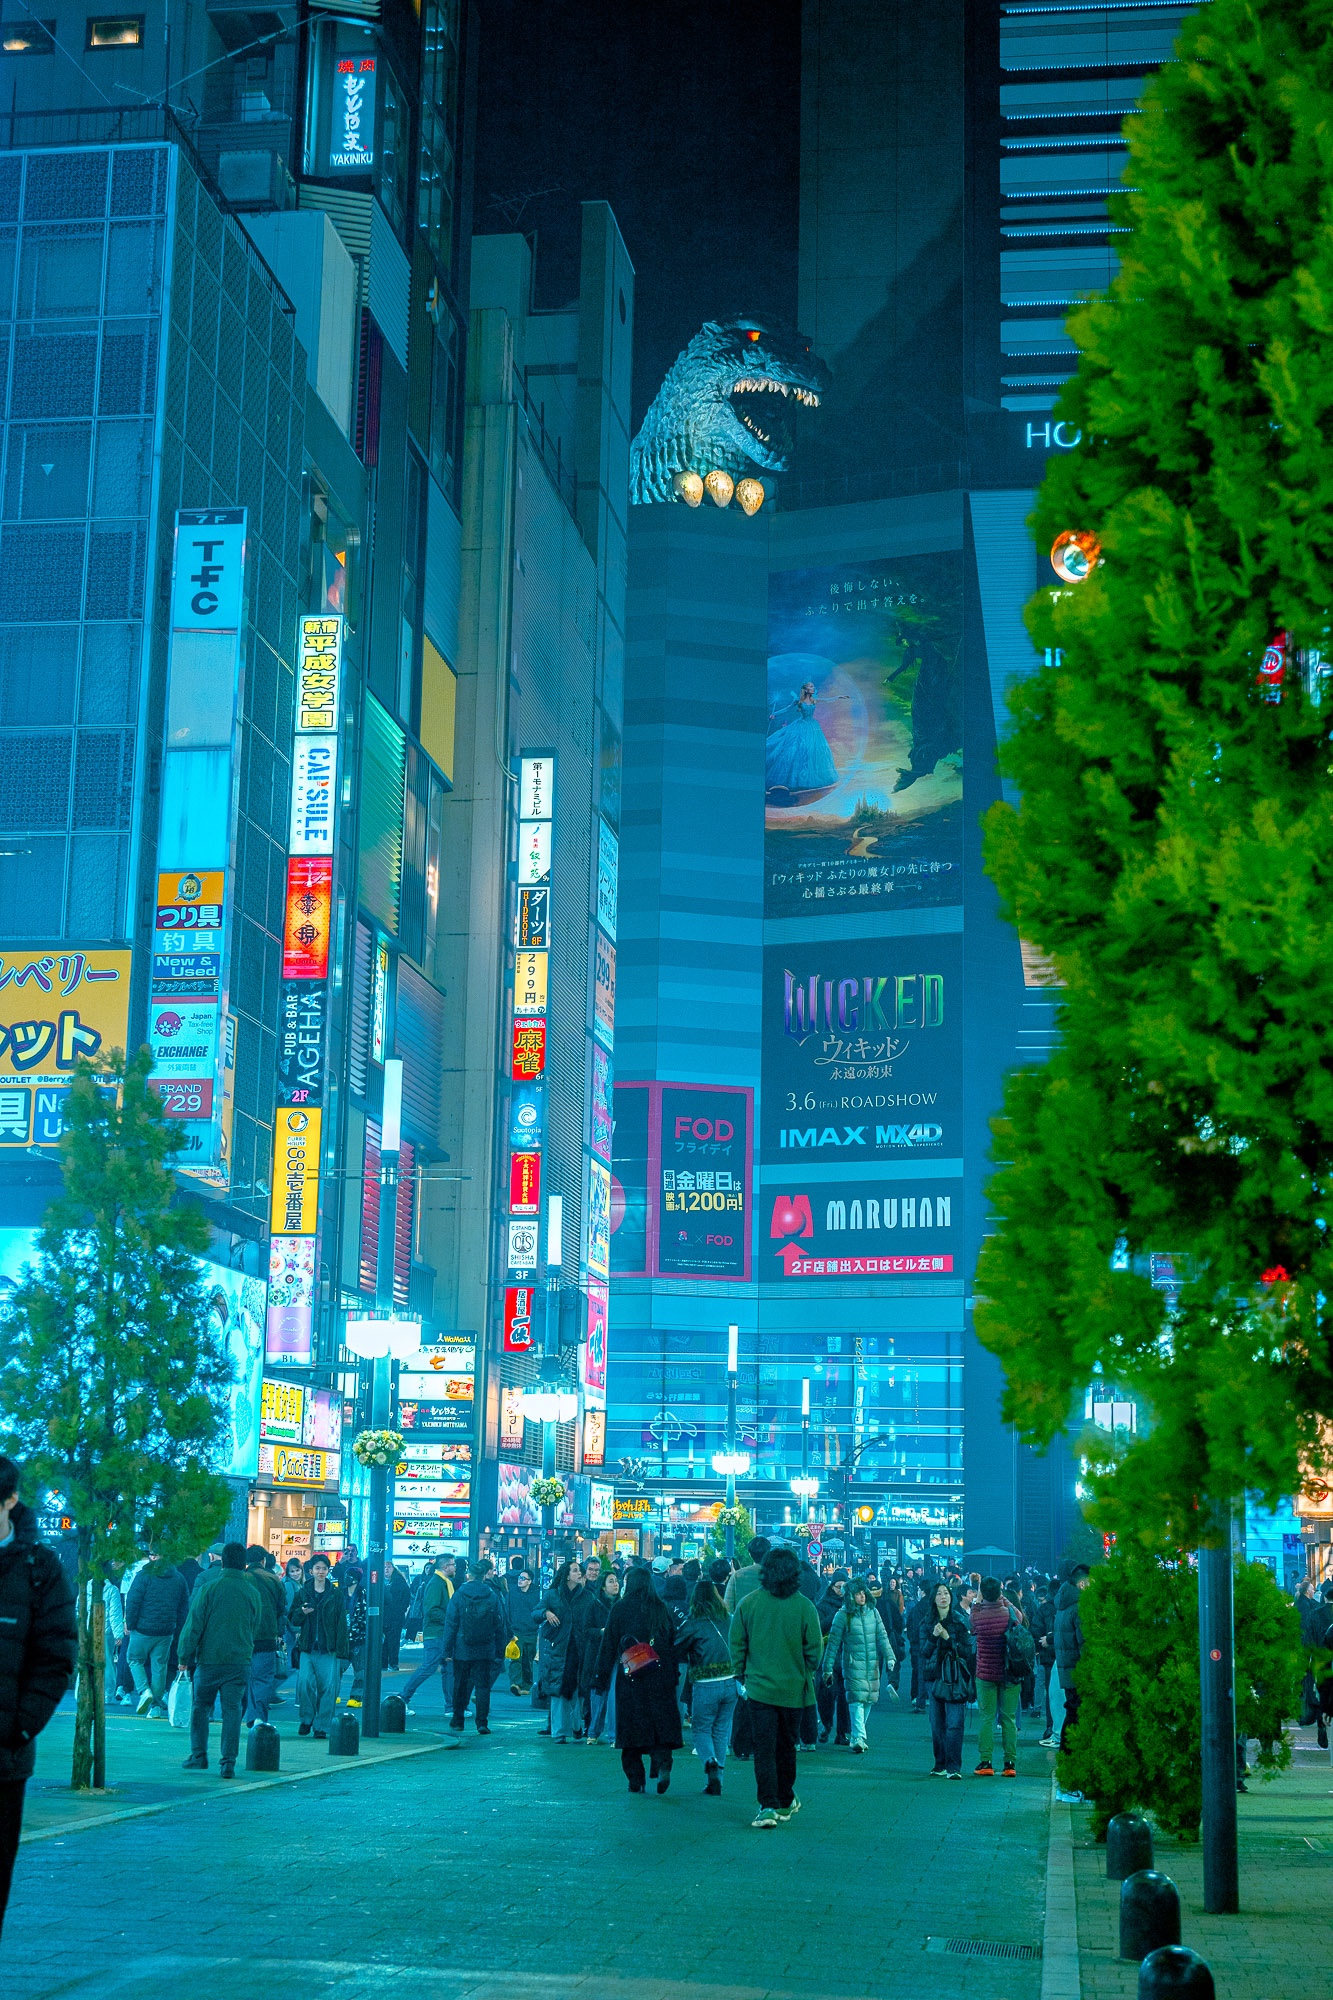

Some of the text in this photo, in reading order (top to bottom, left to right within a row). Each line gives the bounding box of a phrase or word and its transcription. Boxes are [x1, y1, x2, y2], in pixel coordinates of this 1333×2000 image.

[337, 59, 376, 73] 焼肉
[331, 153, 374, 165] YAKINIKU
[1026, 421, 1088, 449] HO
[196, 515, 228, 524] 7F
[190, 540, 225, 615] TFC
[829, 578, 901, 595] 後悔しない、
[805, 594, 926, 616] ふたりで出す答えを。
[303, 620, 339, 634] 新宿
[301, 635, 337, 728] 平成女学園
[296, 754, 305, 836] SHINJUKU
[304, 748, 330, 840] CAPSULE
[158, 905, 220, 928] つり具
[531, 891, 546, 934] ダーツ
[531, 937, 543, 945] 8F
[156, 956, 212, 967] New &
[171, 966, 216, 977] Used
[783, 968, 944, 1047] WICKED
[190, 1013, 214, 1021] Japan.
[284, 995, 298, 1055] PUB & BAR
[515, 1020, 545, 1028] ウェルカム
[297, 991, 322, 1088] AGEHA
[822, 1034, 900, 1060] ウィキッド
[156, 1046, 208, 1058] EXCHANGE
[514, 1030, 544, 1074] 麻雀
[535, 1073, 544, 1081] 6F
[829, 1065, 893, 1080] 永遠の約束
[159, 1084, 202, 1093] BRAND
[291, 1090, 309, 1102] 2F
[786, 1091, 938, 1111] 3.6 (Fri.) ROADSHOW
[674, 1117, 734, 1141] FOD
[780, 1123, 943, 1148] IMAX MX4D
[674, 1142, 732, 1156] フライデイ
[664, 1170, 742, 1191] 毎週 金曜日は
[826, 1196, 951, 1230] MARUHAN
[706, 1235, 733, 1246] FOD
[791, 1257, 944, 1274] 2F店舗出入口はビル左側
[515, 1270, 529, 1280] 3F
[516, 1289, 527, 1316] 居酒屋
[282, 1354, 297, 1363] B1F
